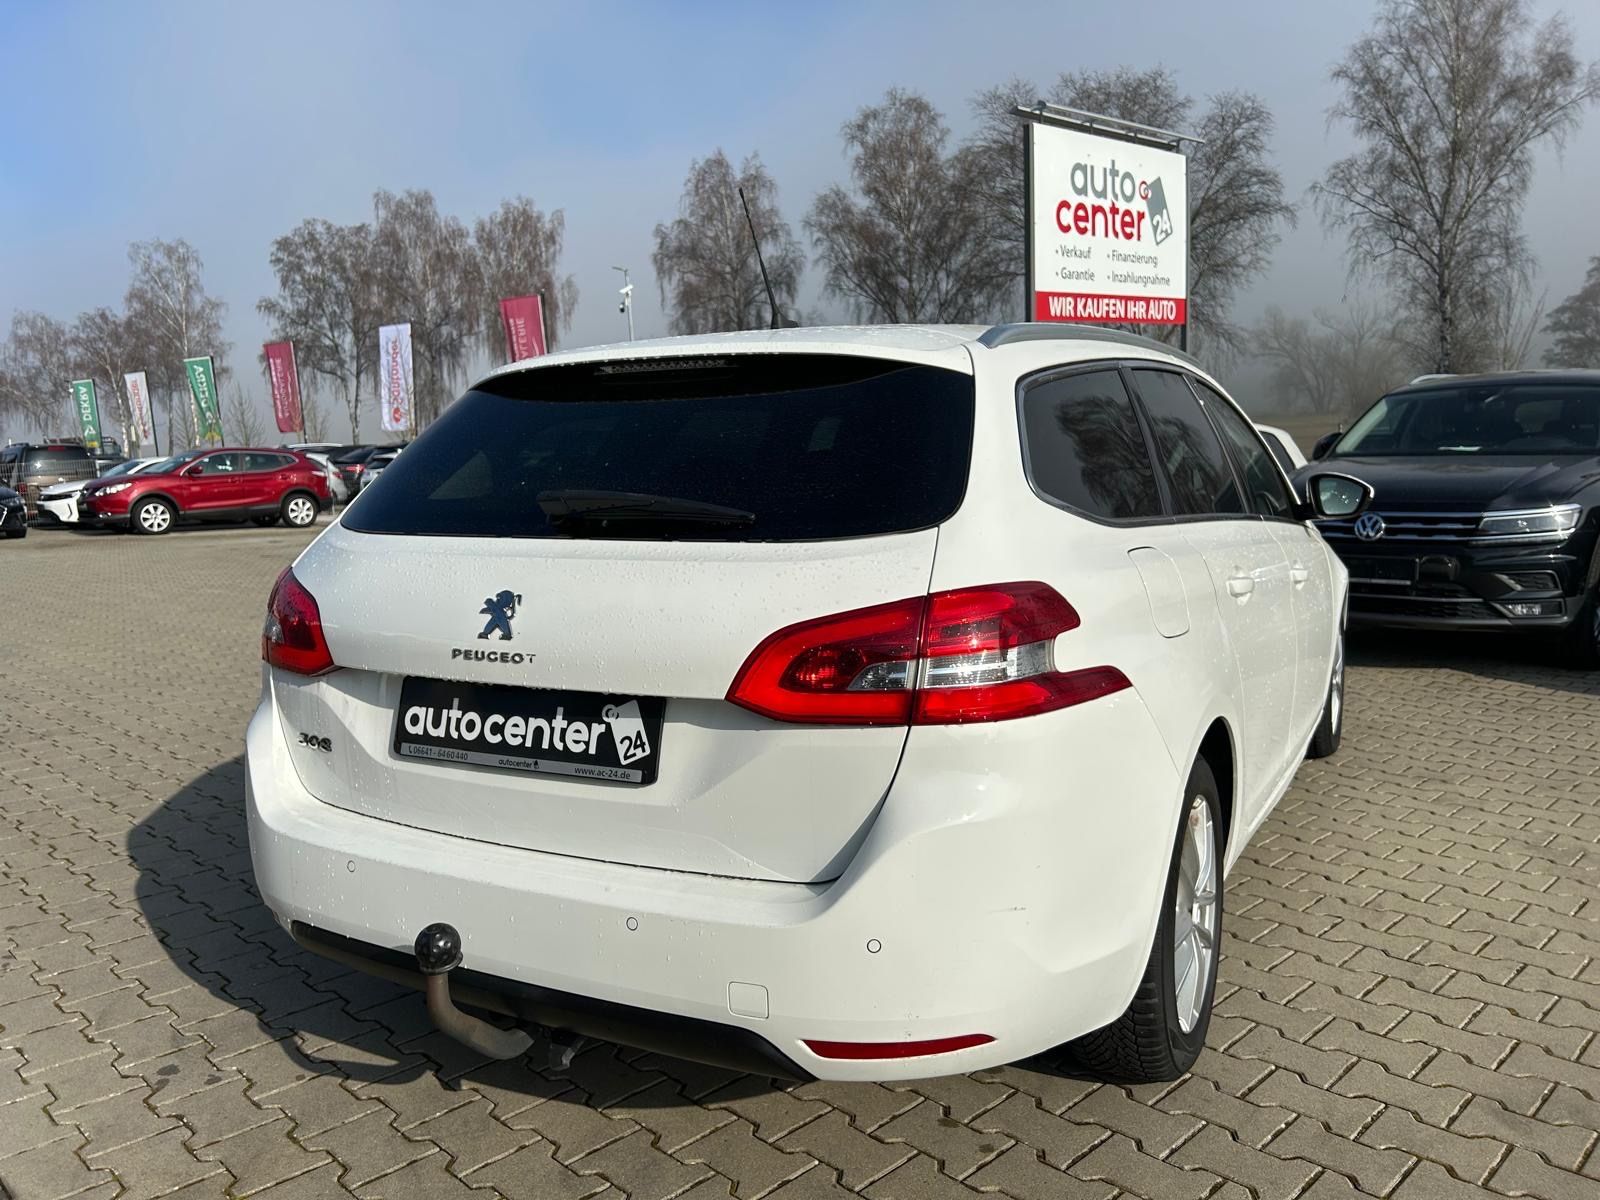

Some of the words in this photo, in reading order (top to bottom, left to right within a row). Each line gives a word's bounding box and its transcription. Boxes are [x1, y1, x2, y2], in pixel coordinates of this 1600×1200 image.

[1070, 159, 1136, 203] auto
[1056, 200, 1145, 241] center
[1152, 208, 1171, 240] 24
[1060, 245, 1092, 259] Verkauf
[1111, 249, 1158, 268] Finanzierung
[1061, 267, 1096, 281] Garantie
[1111, 270, 1171, 288] Inzahlungnahme
[1048, 296, 1075, 317] WIR
[1076, 297, 1125, 319] KAUFEN
[1127, 300, 1147, 320] IHR
[1147, 300, 1176, 321] AUTO
[451, 648, 536, 664] PEUGEOT
[404, 697, 606, 755] autocenter
[619, 729, 647, 761] 24
[498, 759, 533, 769] autocenter
[574, 767, 631, 780] www.ac-24.de
